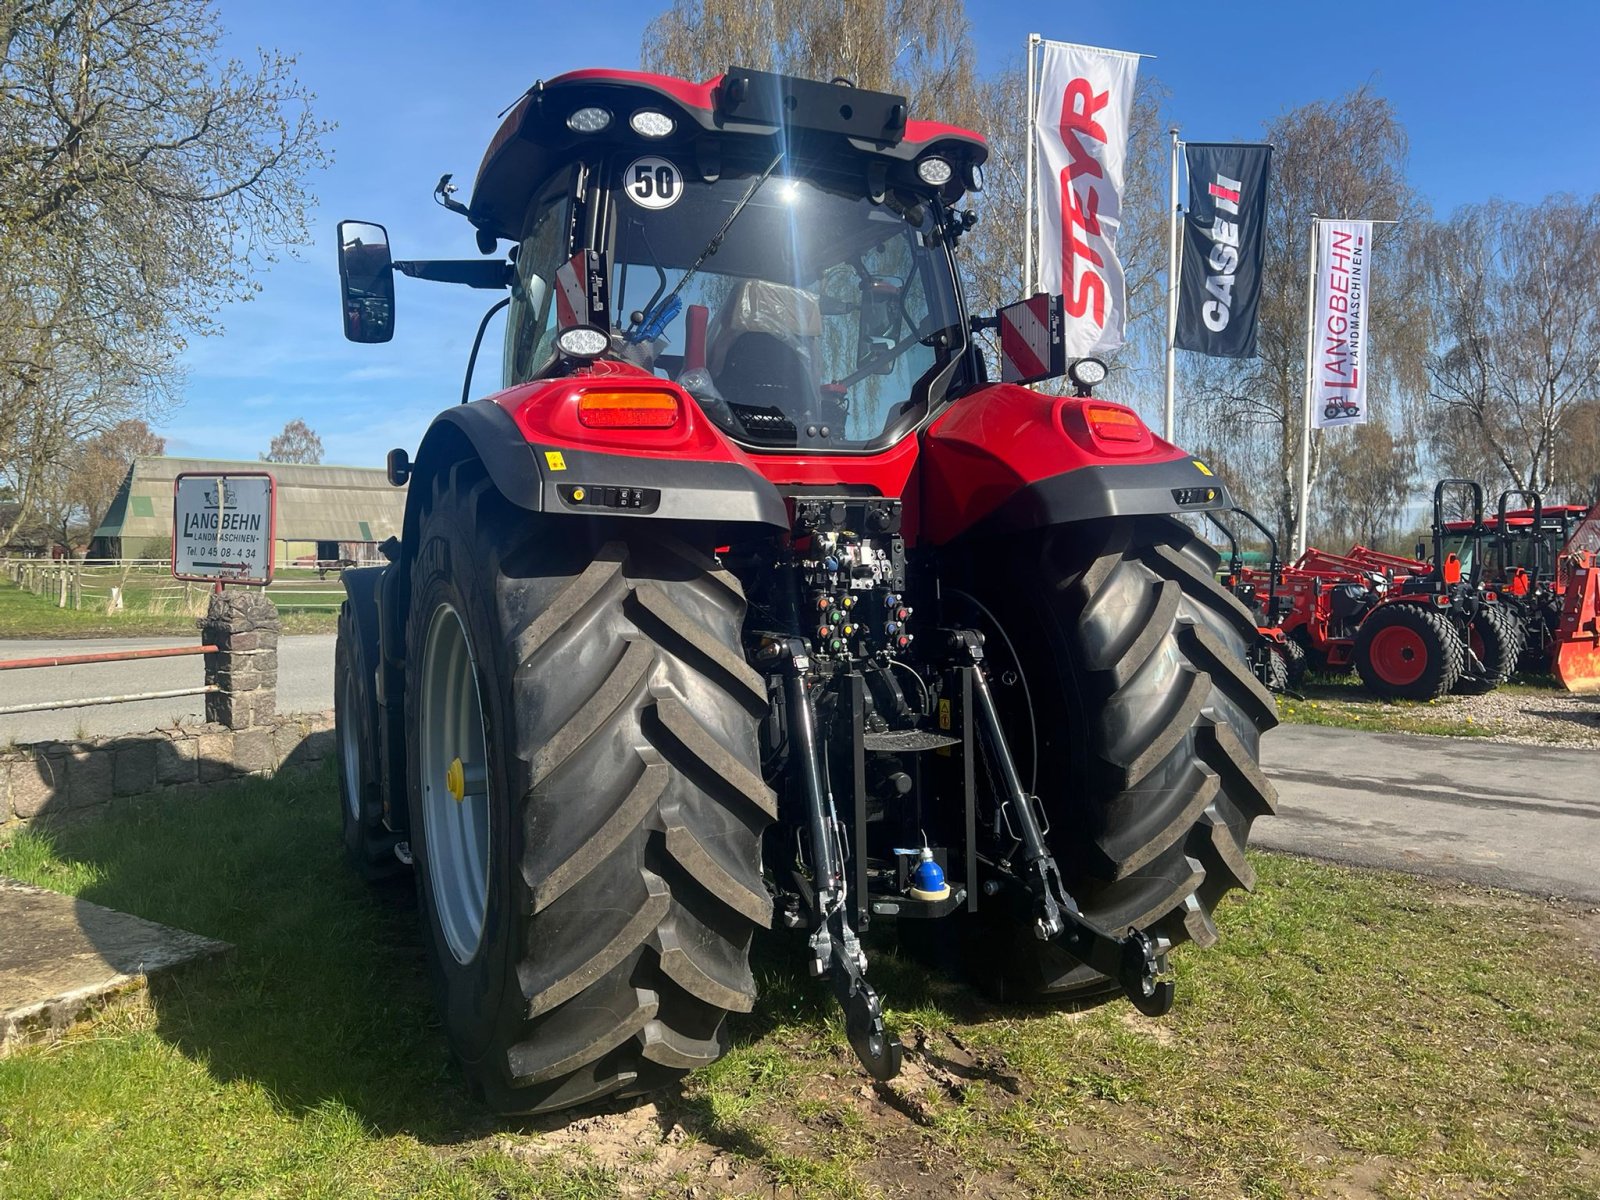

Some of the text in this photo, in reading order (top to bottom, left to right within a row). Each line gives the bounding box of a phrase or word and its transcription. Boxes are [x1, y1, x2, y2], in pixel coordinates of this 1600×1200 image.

[635, 165, 674, 199] 50
[1060, 78, 1109, 329] STEYR
[1324, 230, 1358, 389] LANGBEHN
[183, 513, 261, 538] LANGBEHN
[186, 546, 197, 556] Tel.
[200, 547, 206, 556] 0
[207, 547, 218, 557] 45
[245, 549, 256, 558] 34
